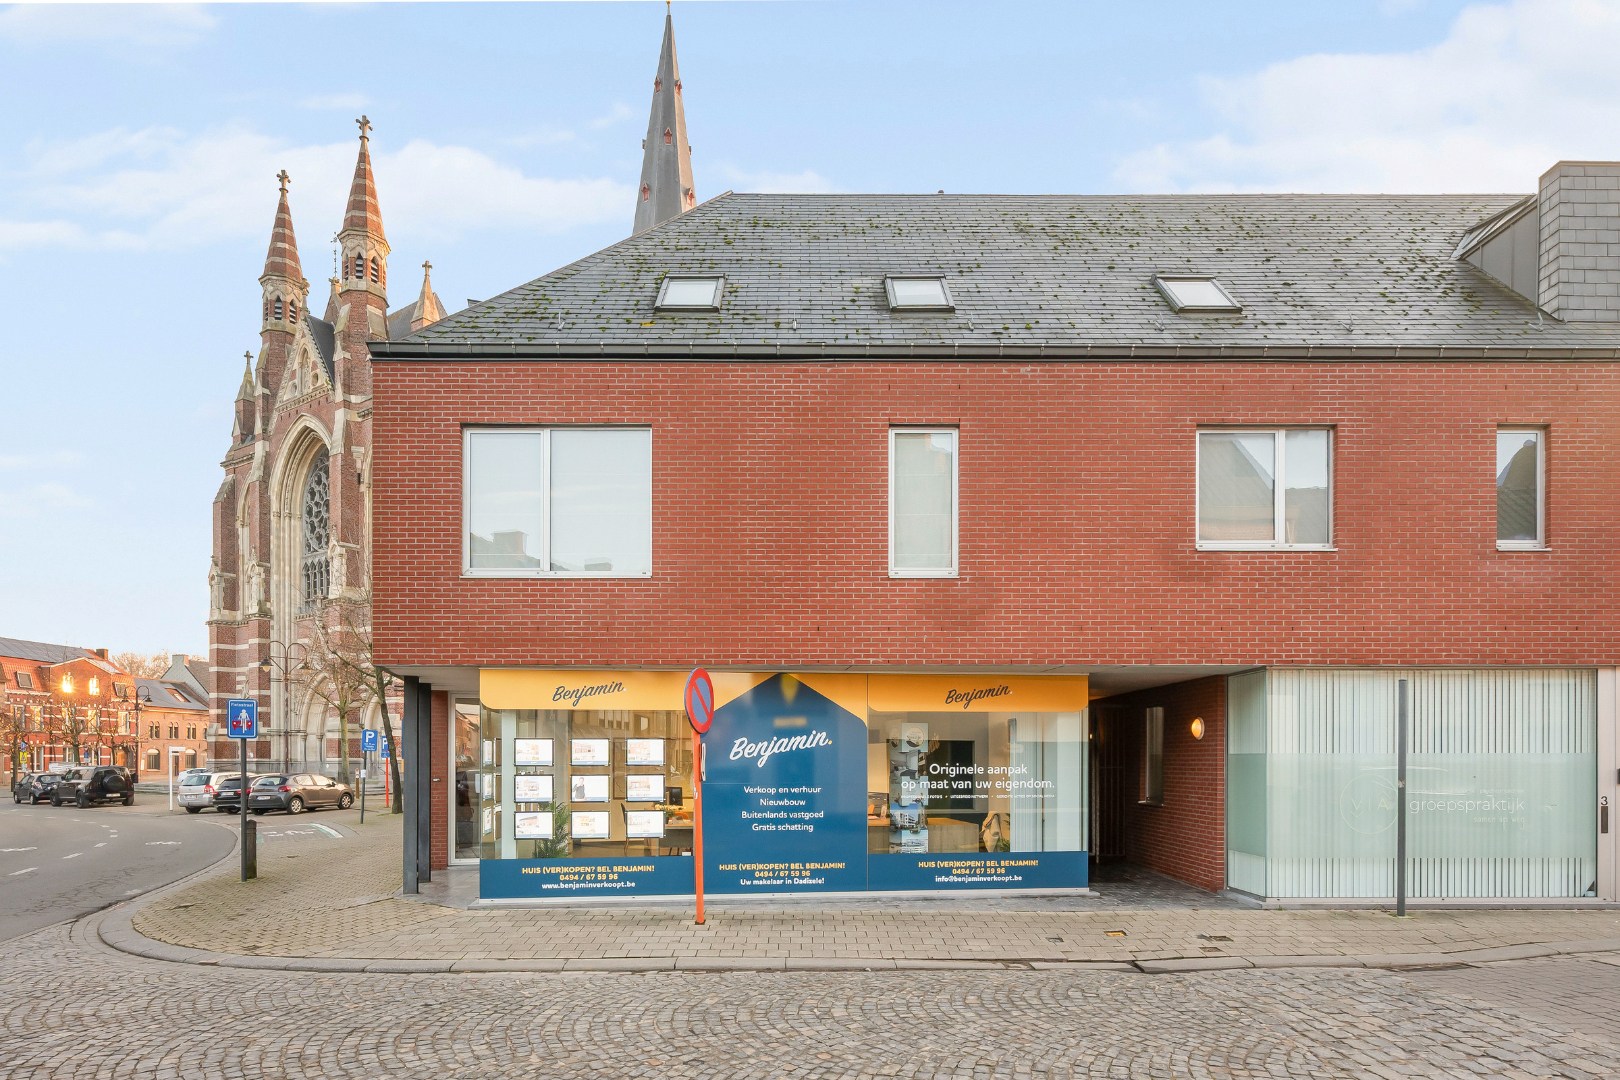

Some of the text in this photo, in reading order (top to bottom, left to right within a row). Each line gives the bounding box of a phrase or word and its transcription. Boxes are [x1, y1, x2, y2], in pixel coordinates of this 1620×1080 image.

[365, 731, 375, 743] P
[929, 763, 1028, 777] Originele aanpak
[901, 778, 1055, 791] op maat van uw eigendom.
[743, 786, 776, 795] Verkoop
[790, 785, 821, 794] verhuur
[759, 798, 806, 806] Nieuwbouw
[1409, 796, 1526, 814] groepspraktijk
[1601, 796, 1608, 805] 3
[741, 810, 824, 820] Buitenlands vastgoed
[752, 823, 814, 832] Gratis schatting
[738, 863, 788, 871] (VER)KOPEN?
[937, 860, 984, 868] (VER)KOPEN?
[542, 866, 595, 874] (VER)KOPEN?
[935, 875, 1022, 883] info@benjaminverkoopt.be
[541, 880, 636, 890] www.benjaminverkoopt.be
